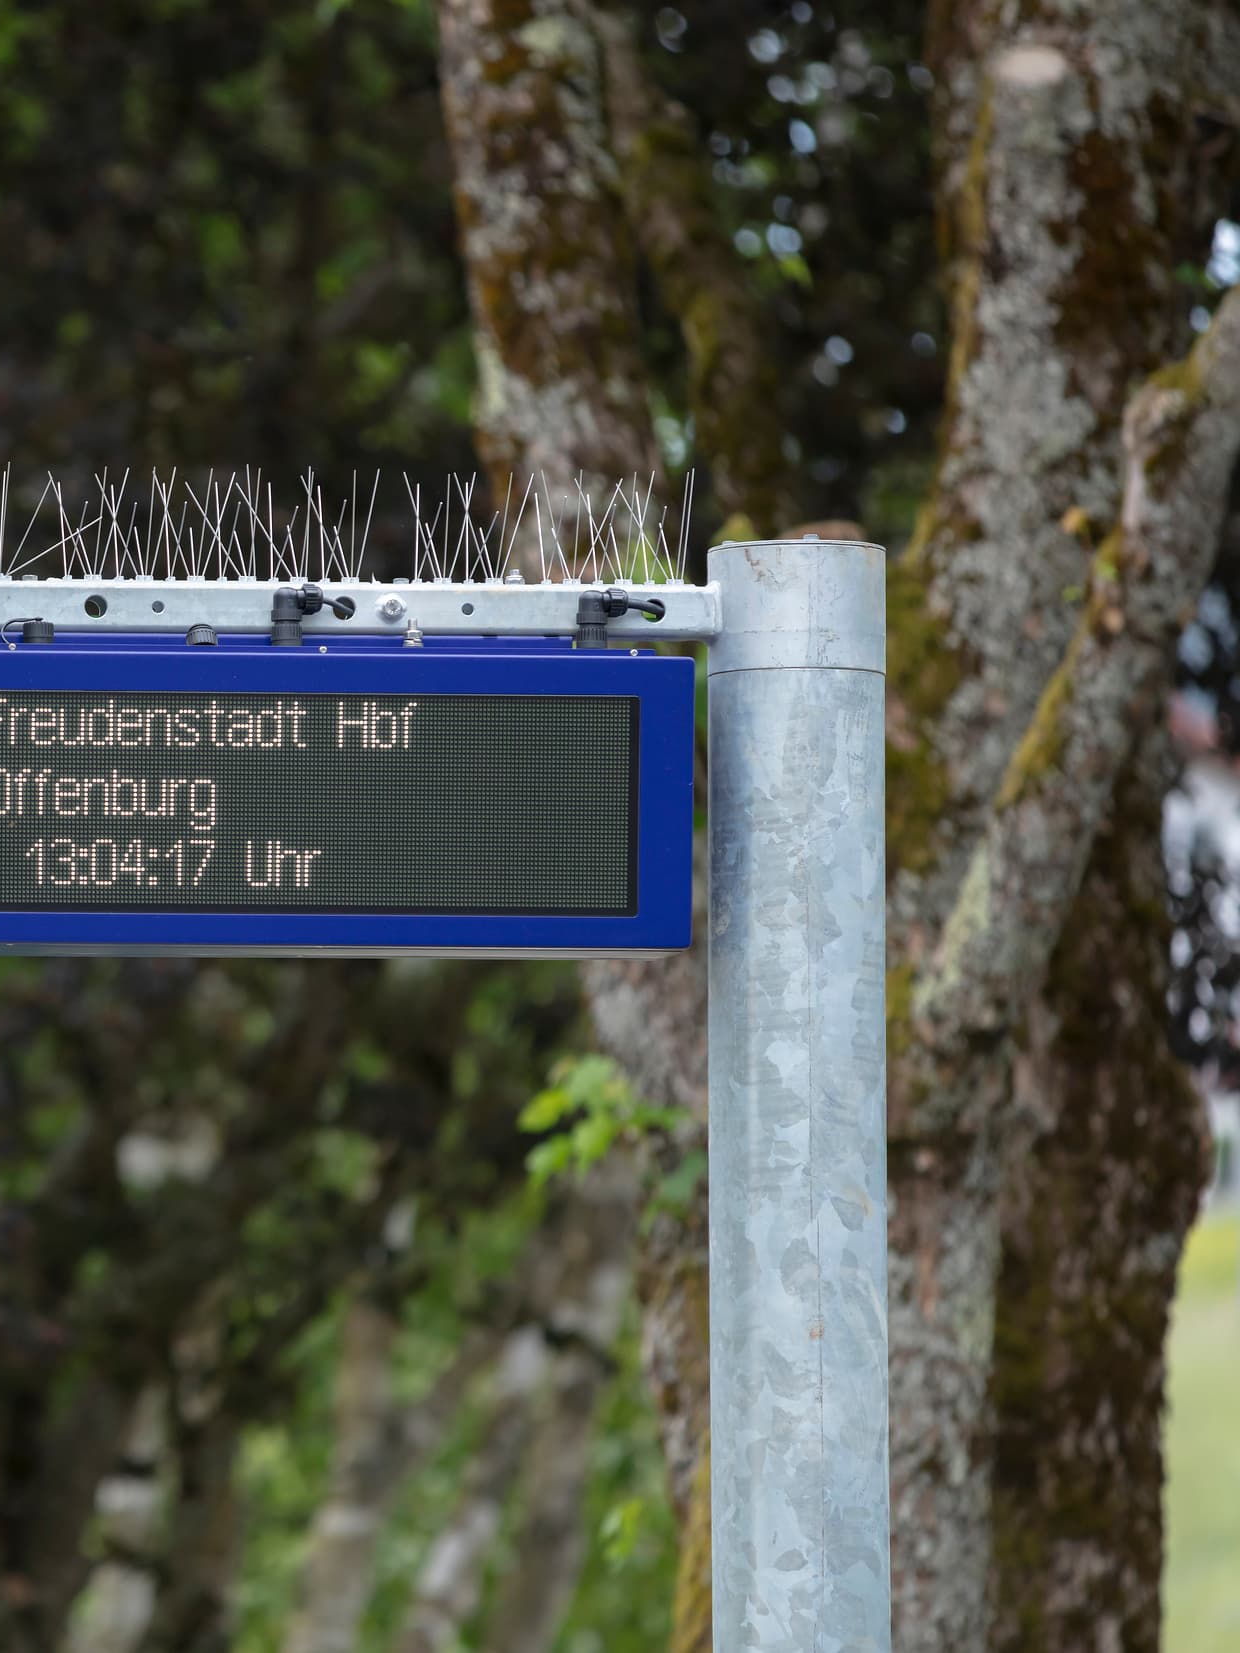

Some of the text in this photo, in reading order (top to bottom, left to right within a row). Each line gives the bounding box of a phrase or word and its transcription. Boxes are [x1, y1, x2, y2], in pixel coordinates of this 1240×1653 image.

[337, 700, 418, 749] Hbf
[25, 837, 322, 888] 13:04:17 Uhr
